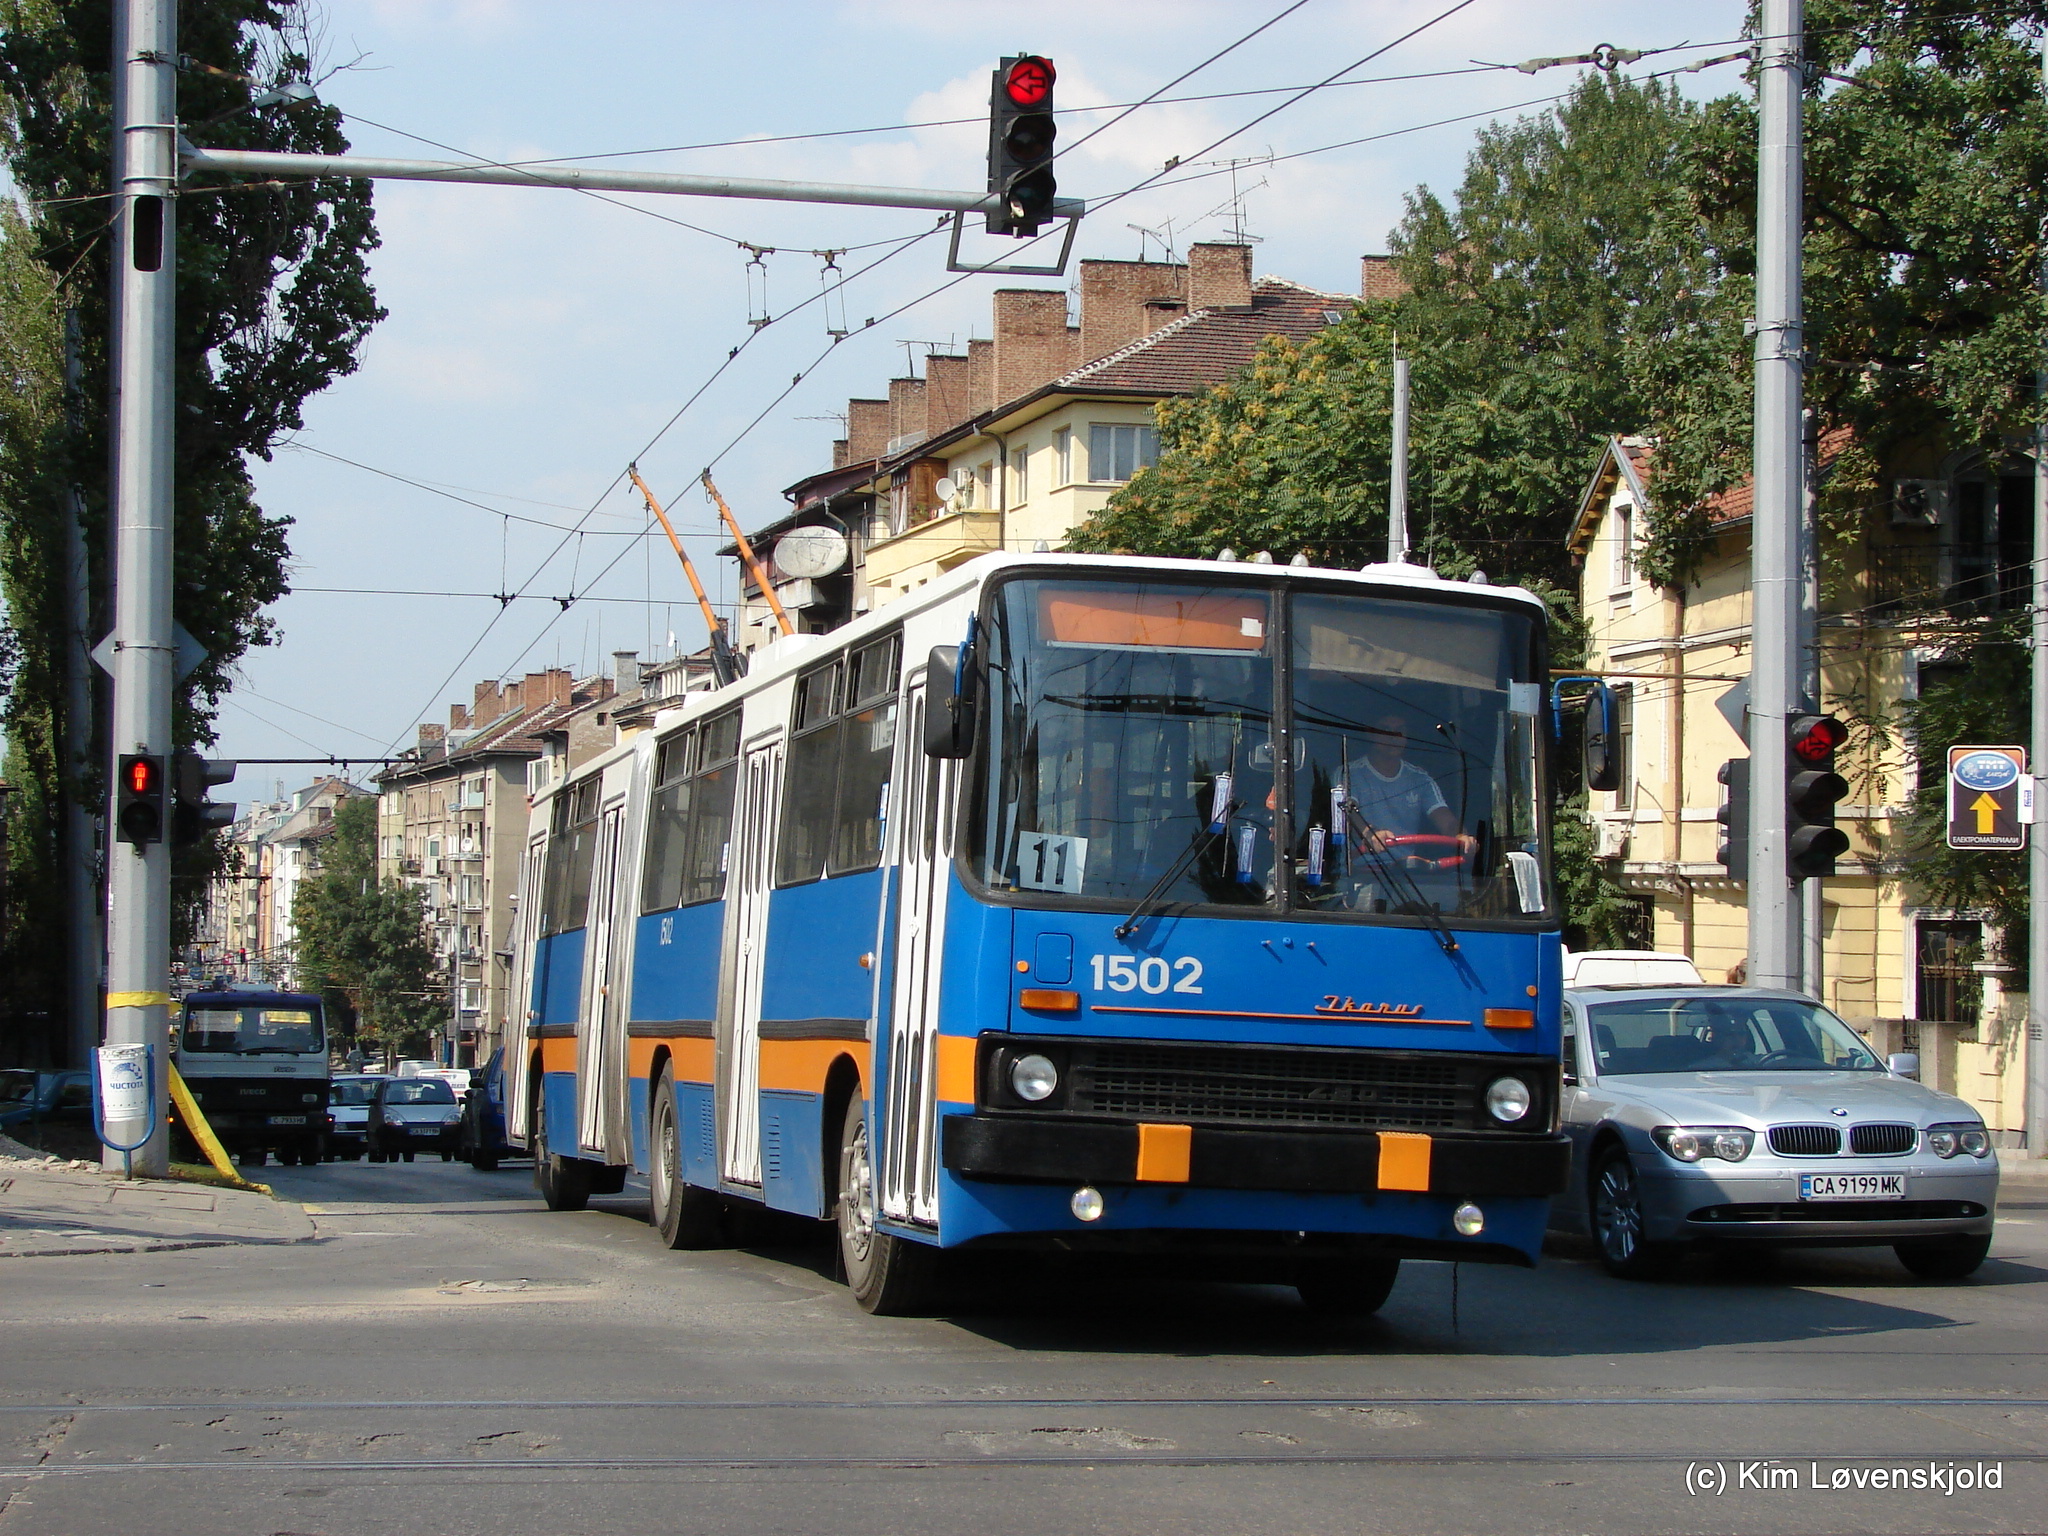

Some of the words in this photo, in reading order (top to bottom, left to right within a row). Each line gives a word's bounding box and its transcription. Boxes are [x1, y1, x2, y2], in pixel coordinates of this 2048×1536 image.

[1952, 836, 2019, 844] ЕЛЕКТРОМАТЕРИАЛИ
[1033, 839, 1069, 885] 11
[1090, 954, 1203, 994] 1502
[1314, 995, 1423, 1015] Ikarus
[1813, 1178, 1835, 1194] CA
[1839, 1177, 1878, 1193] 9199
[1881, 1176, 1901, 1193] MK
